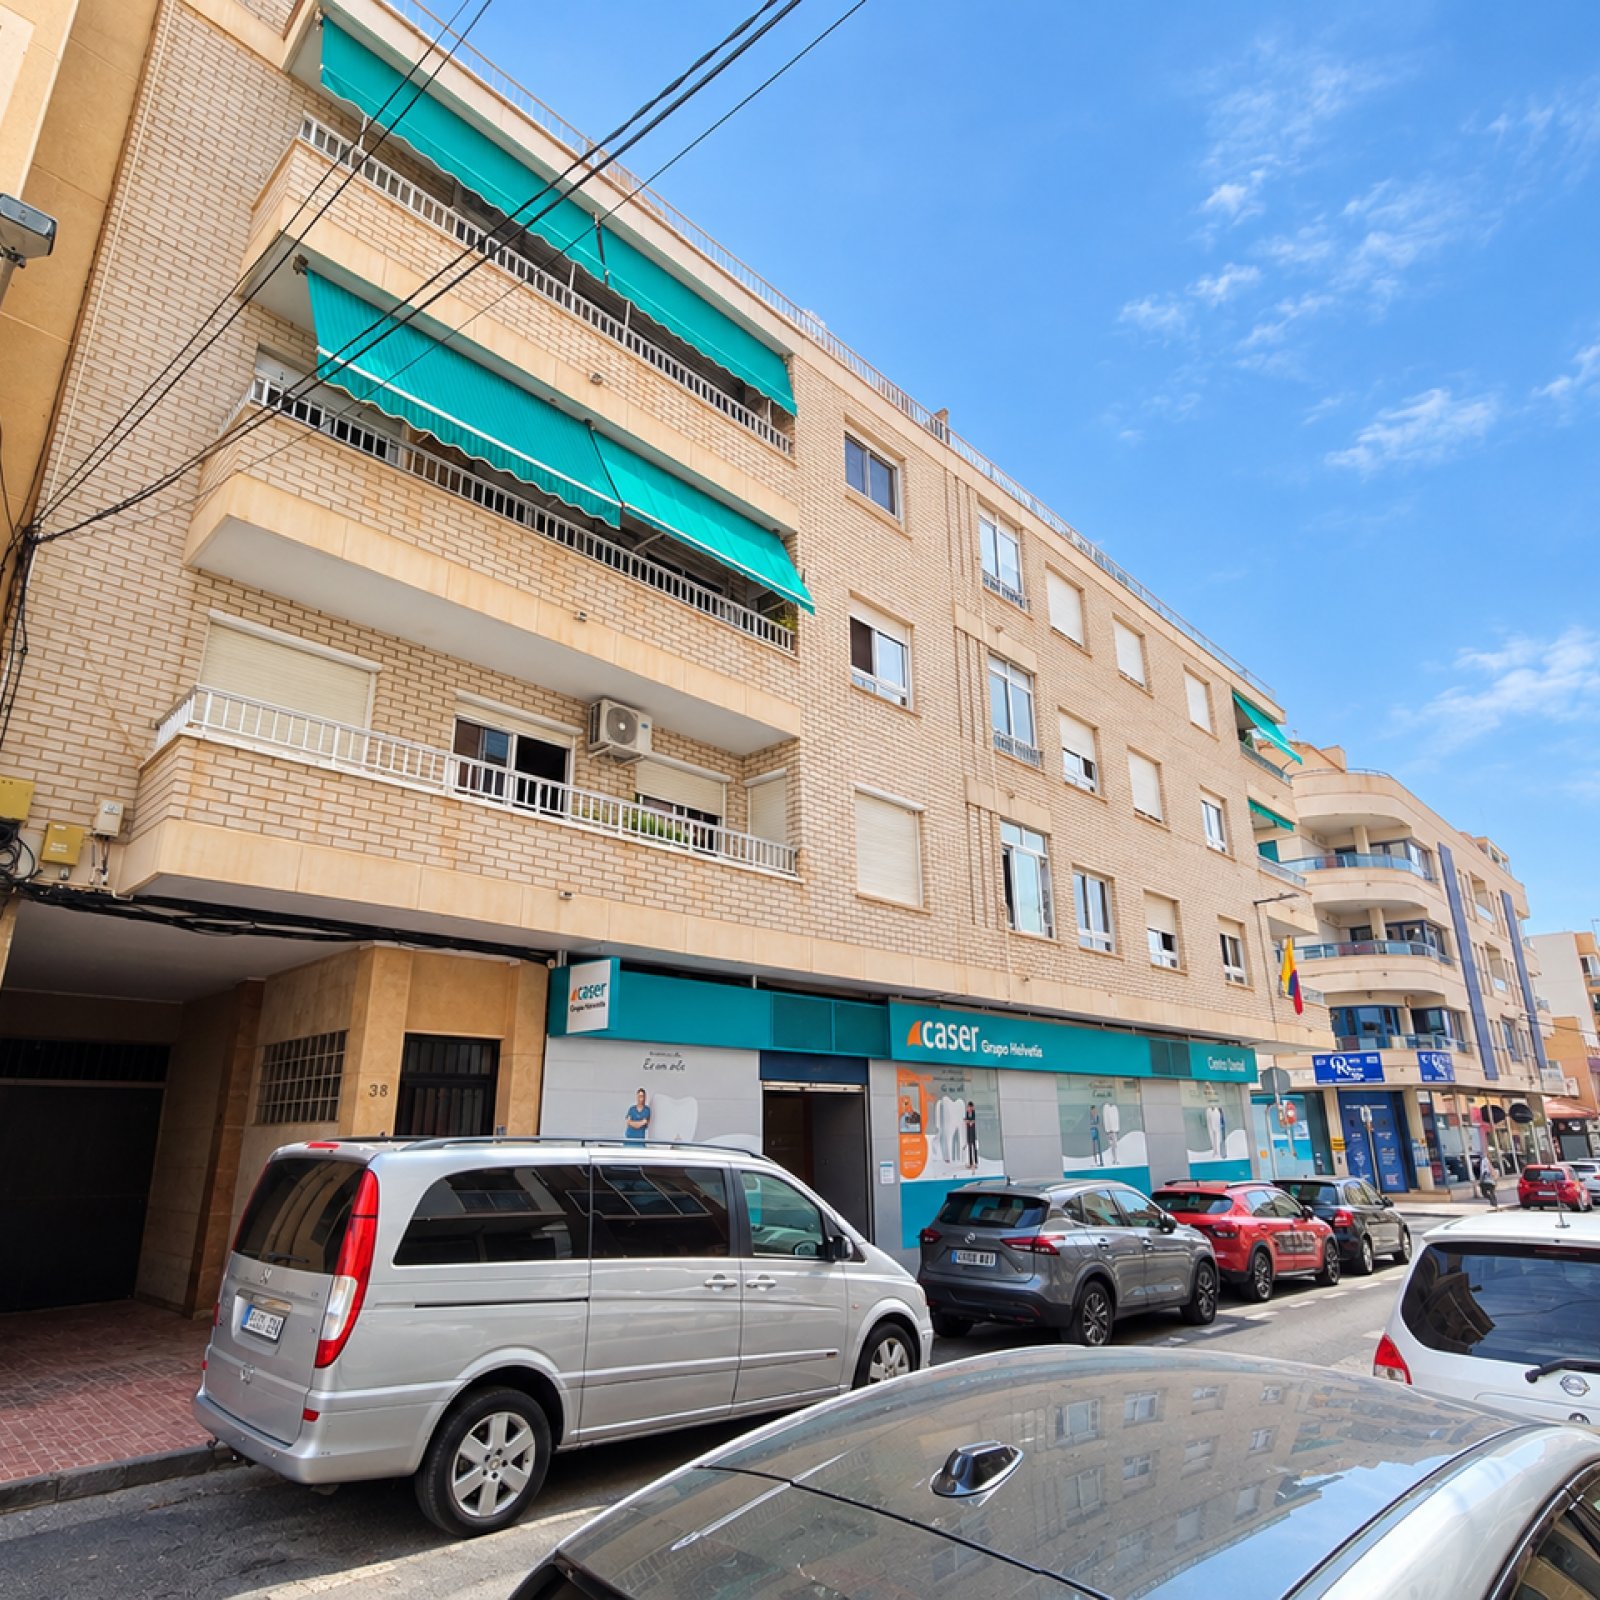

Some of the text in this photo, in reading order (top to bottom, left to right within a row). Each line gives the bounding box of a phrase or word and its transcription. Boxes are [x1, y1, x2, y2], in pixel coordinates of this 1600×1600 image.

[578, 983, 608, 1001] caser
[922, 1020, 979, 1052] caser
[981, 1040, 1043, 1058] Grupo Helvetia
[368, 1084, 389, 1098] 38
